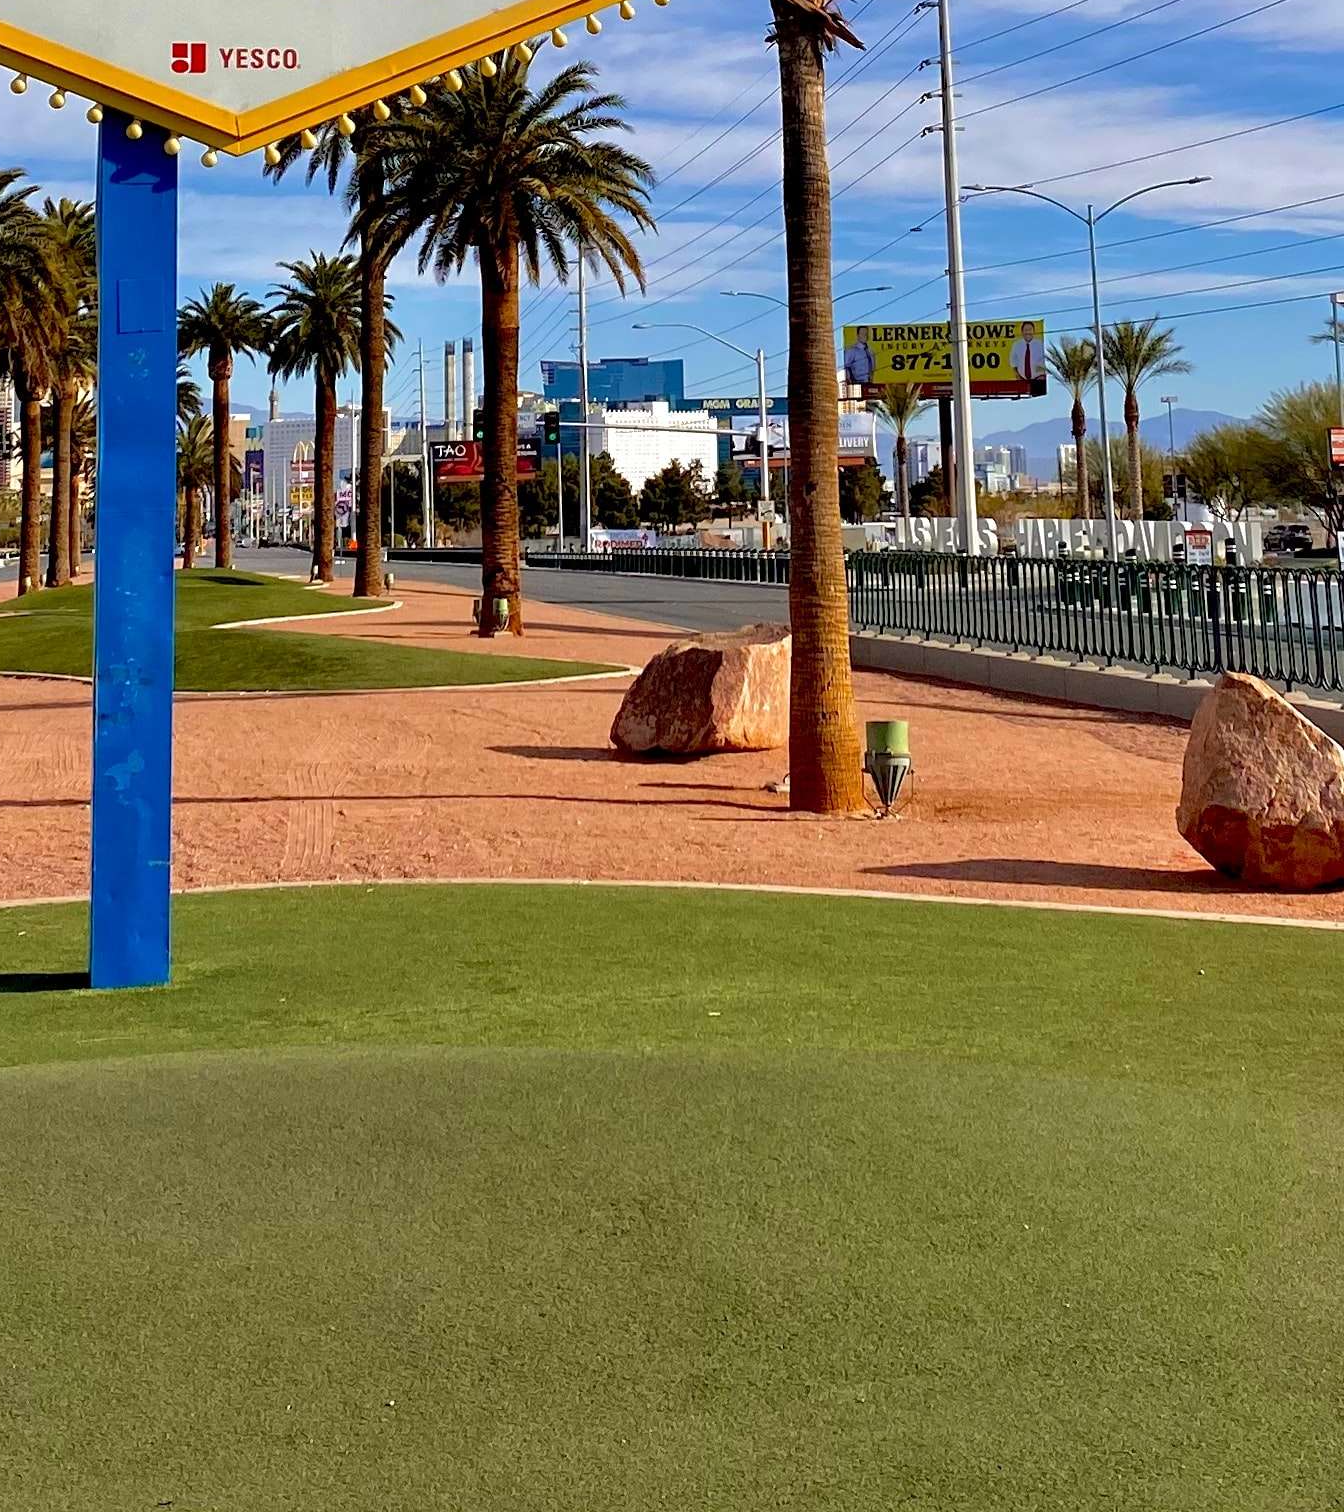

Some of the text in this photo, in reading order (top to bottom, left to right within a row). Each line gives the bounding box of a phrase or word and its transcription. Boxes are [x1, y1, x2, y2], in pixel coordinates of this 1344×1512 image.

[219, 48, 298, 69] YESCO
[872, 325, 945, 342] LERNER
[891, 351, 1001, 371] 877-100
[703, 399, 731, 410] MGM
[434, 444, 467, 457] TAO
